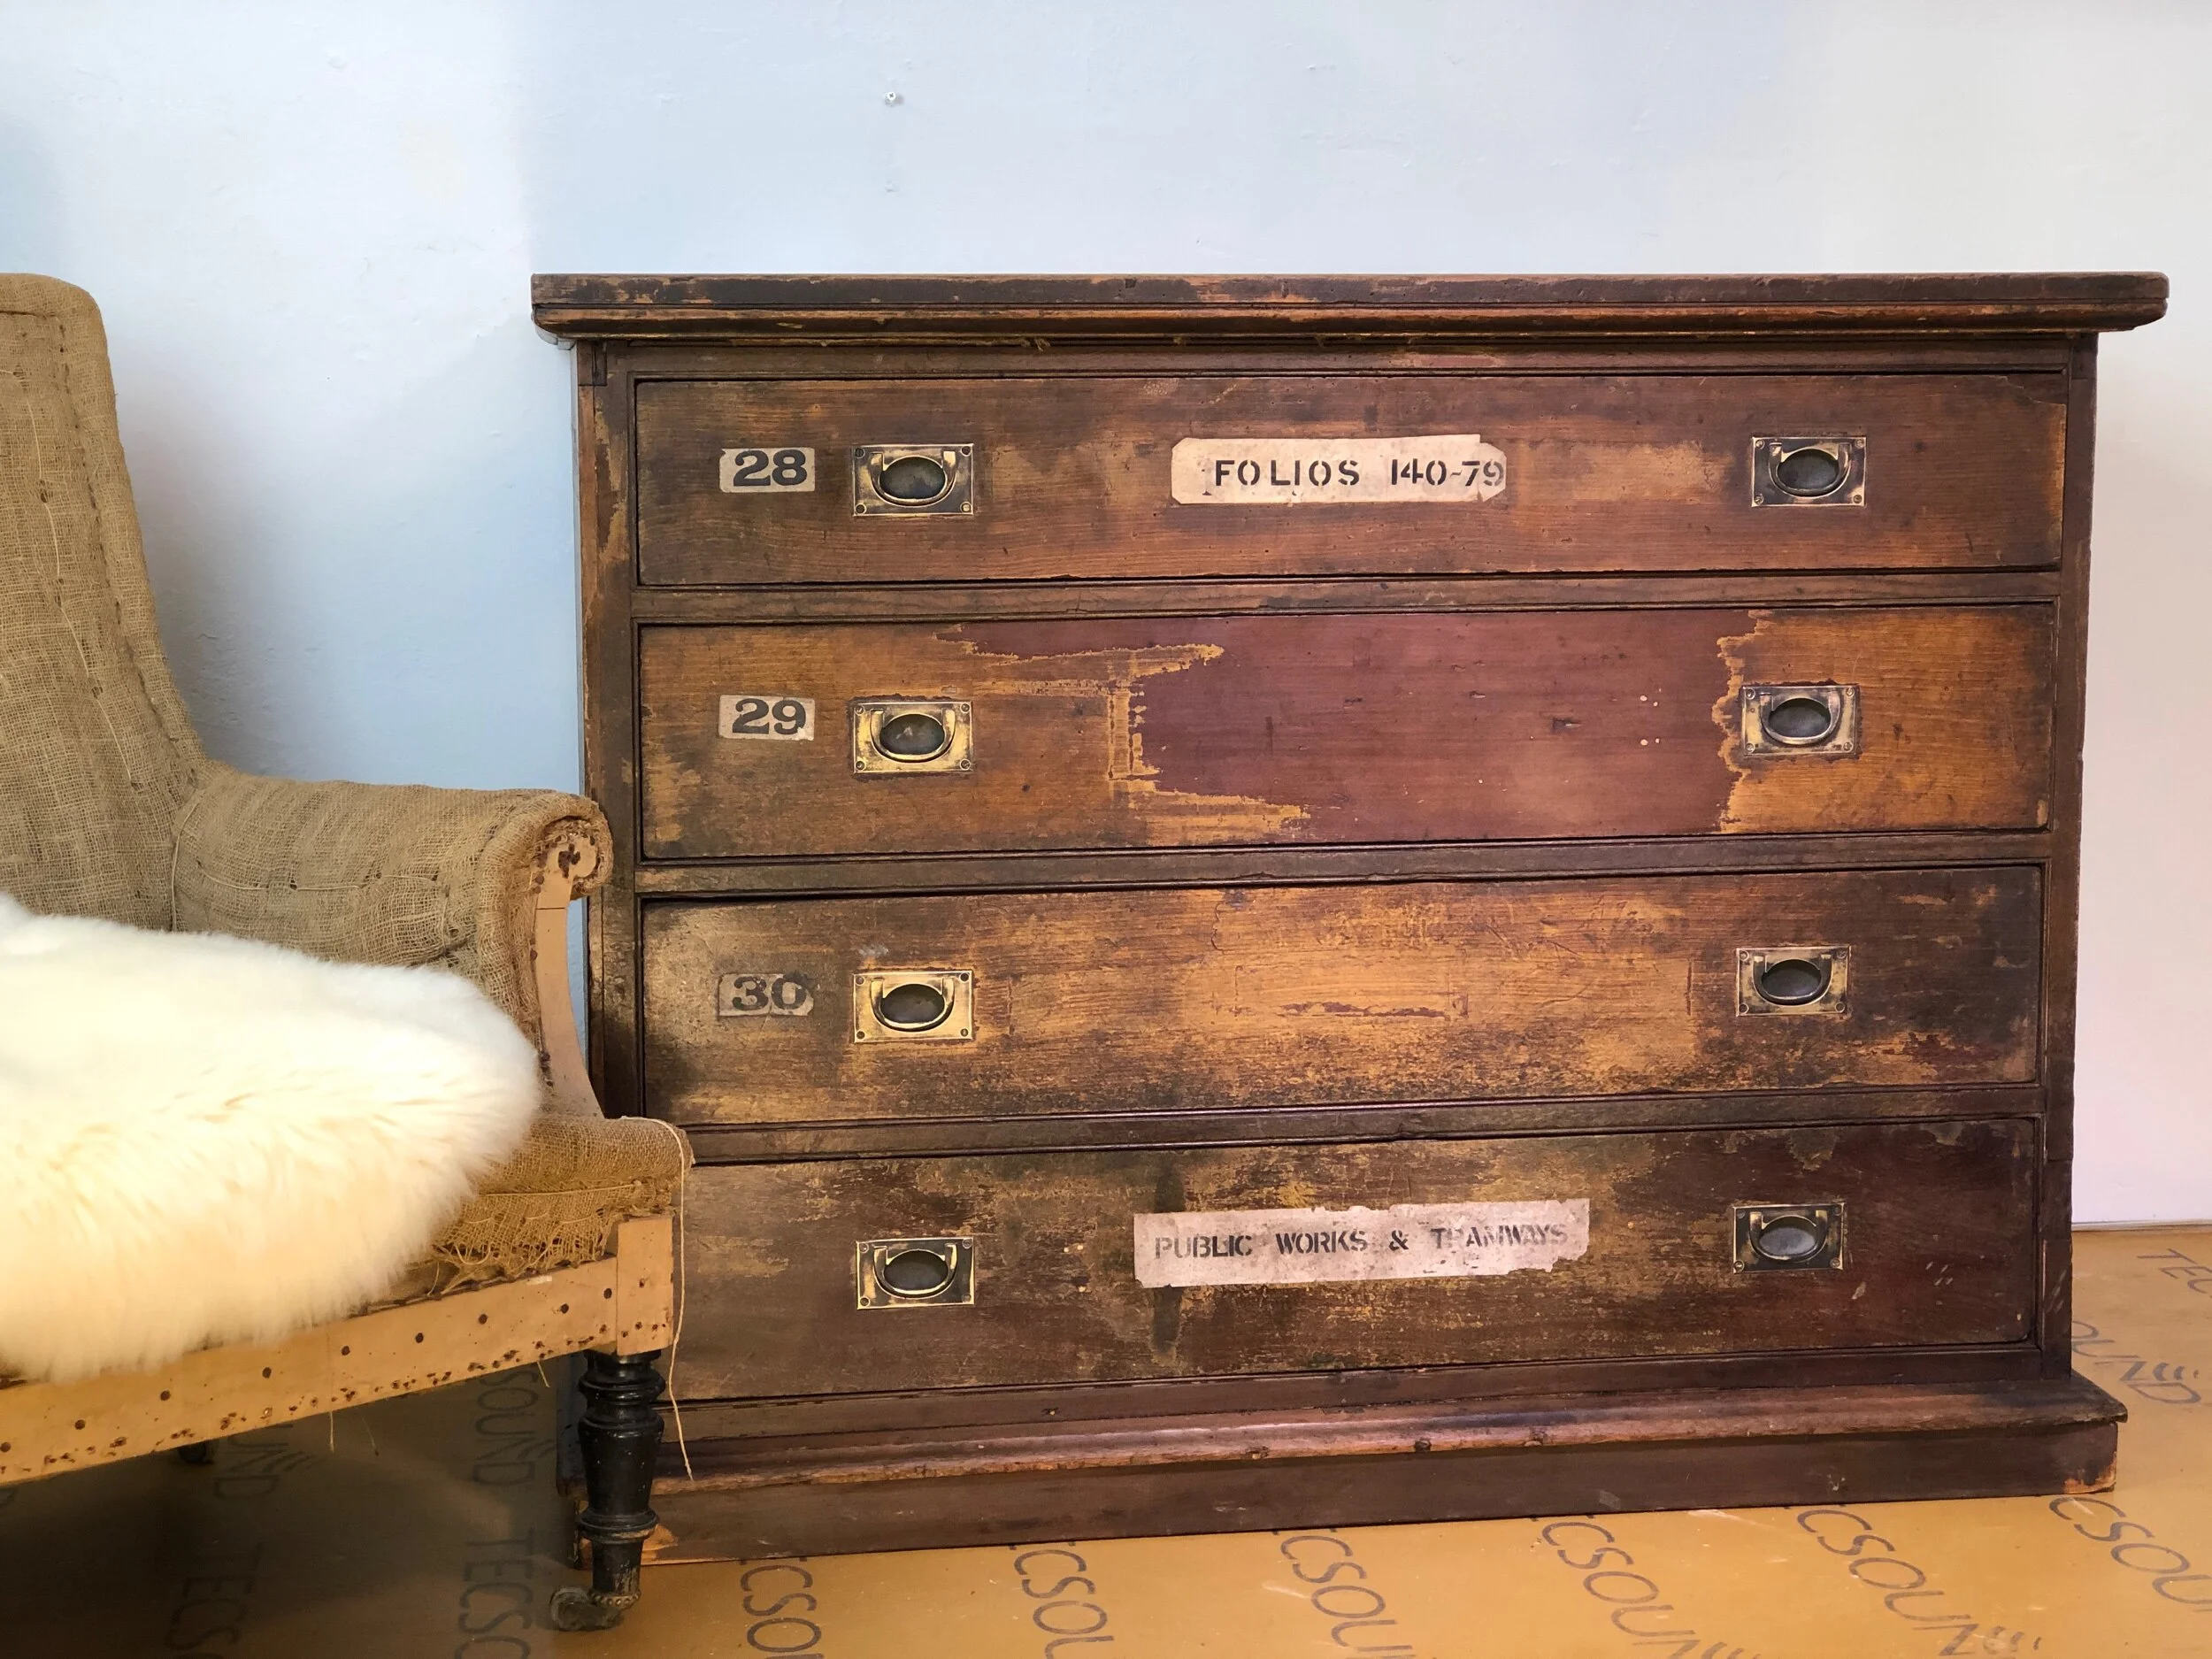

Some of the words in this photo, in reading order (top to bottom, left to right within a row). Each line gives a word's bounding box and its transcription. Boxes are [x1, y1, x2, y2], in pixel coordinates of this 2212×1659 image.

[733, 449, 808, 487] 28
[1215, 459, 1360, 487] FOLIOS
[1391, 457, 1504, 487] 140-79
[732, 698, 807, 735] 29
[731, 974, 808, 1010] 30
[1155, 1235, 1253, 1259] PUBLIC
[1275, 1230, 1369, 1255] WORKS
[1388, 1229, 1409, 1251] &
